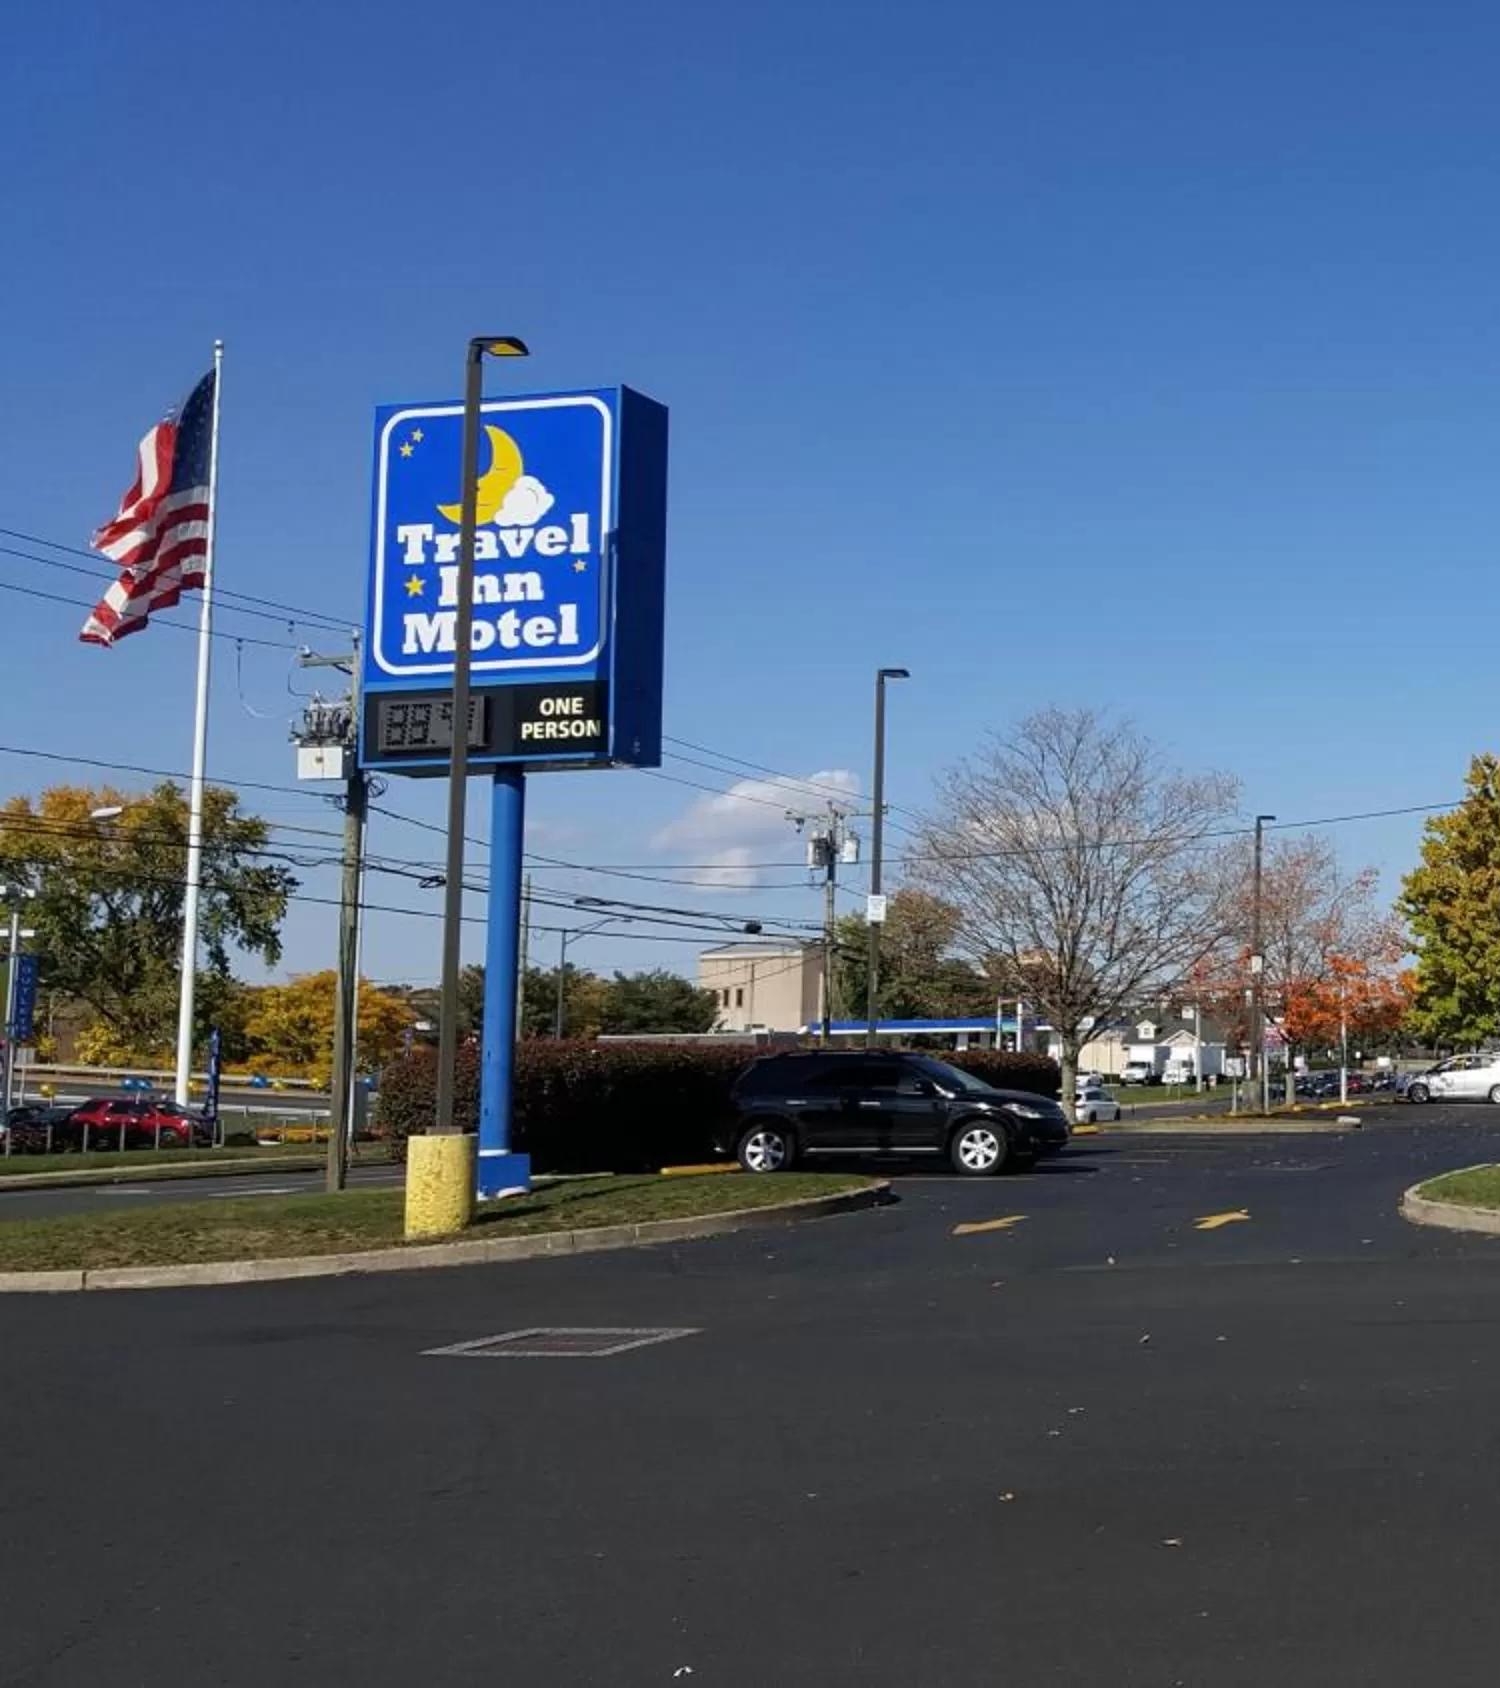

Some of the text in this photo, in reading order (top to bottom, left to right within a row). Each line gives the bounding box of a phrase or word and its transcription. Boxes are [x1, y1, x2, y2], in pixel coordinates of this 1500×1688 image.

[397, 512, 591, 565] Travel
[438, 565, 544, 607] Inn
[402, 603, 580, 655] Motel
[539, 697, 584, 716] ONE
[521, 719, 601, 740] PERSON
